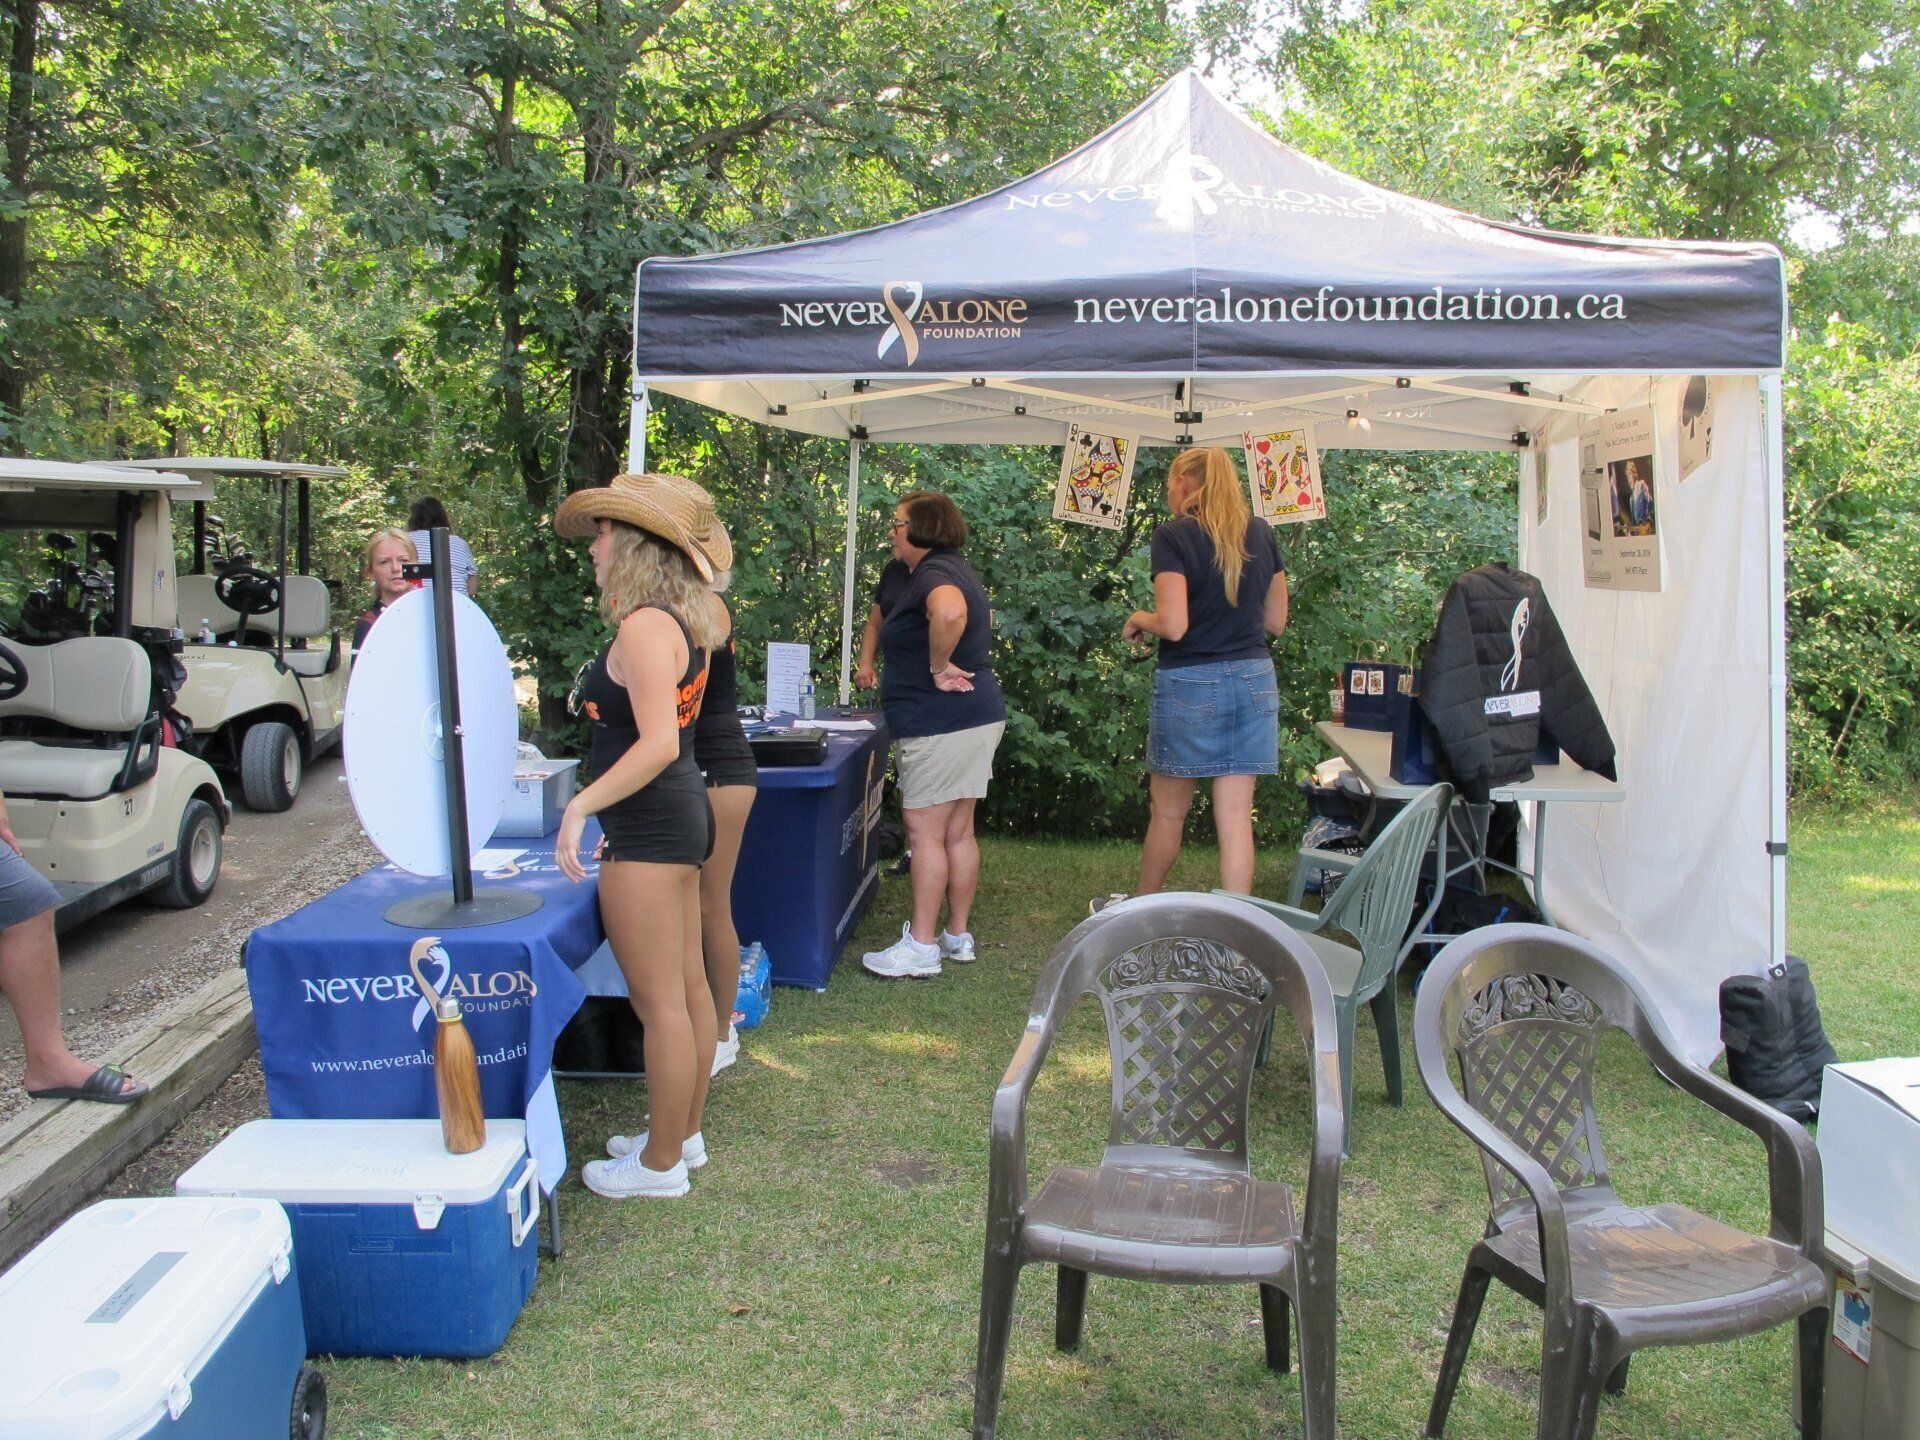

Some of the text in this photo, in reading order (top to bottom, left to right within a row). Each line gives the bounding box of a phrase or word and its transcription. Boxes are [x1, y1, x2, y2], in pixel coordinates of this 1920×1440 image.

[1074, 286, 1627, 325] neveralonefoundation.ca
[923, 327, 1022, 339] FOUNDATION
[1071, 424, 1079, 435] Q
[1244, 431, 1252, 443] K
[1114, 515, 1122, 527] Q
[124, 798, 134, 816] 27
[460, 996, 530, 1013] OUNDAT
